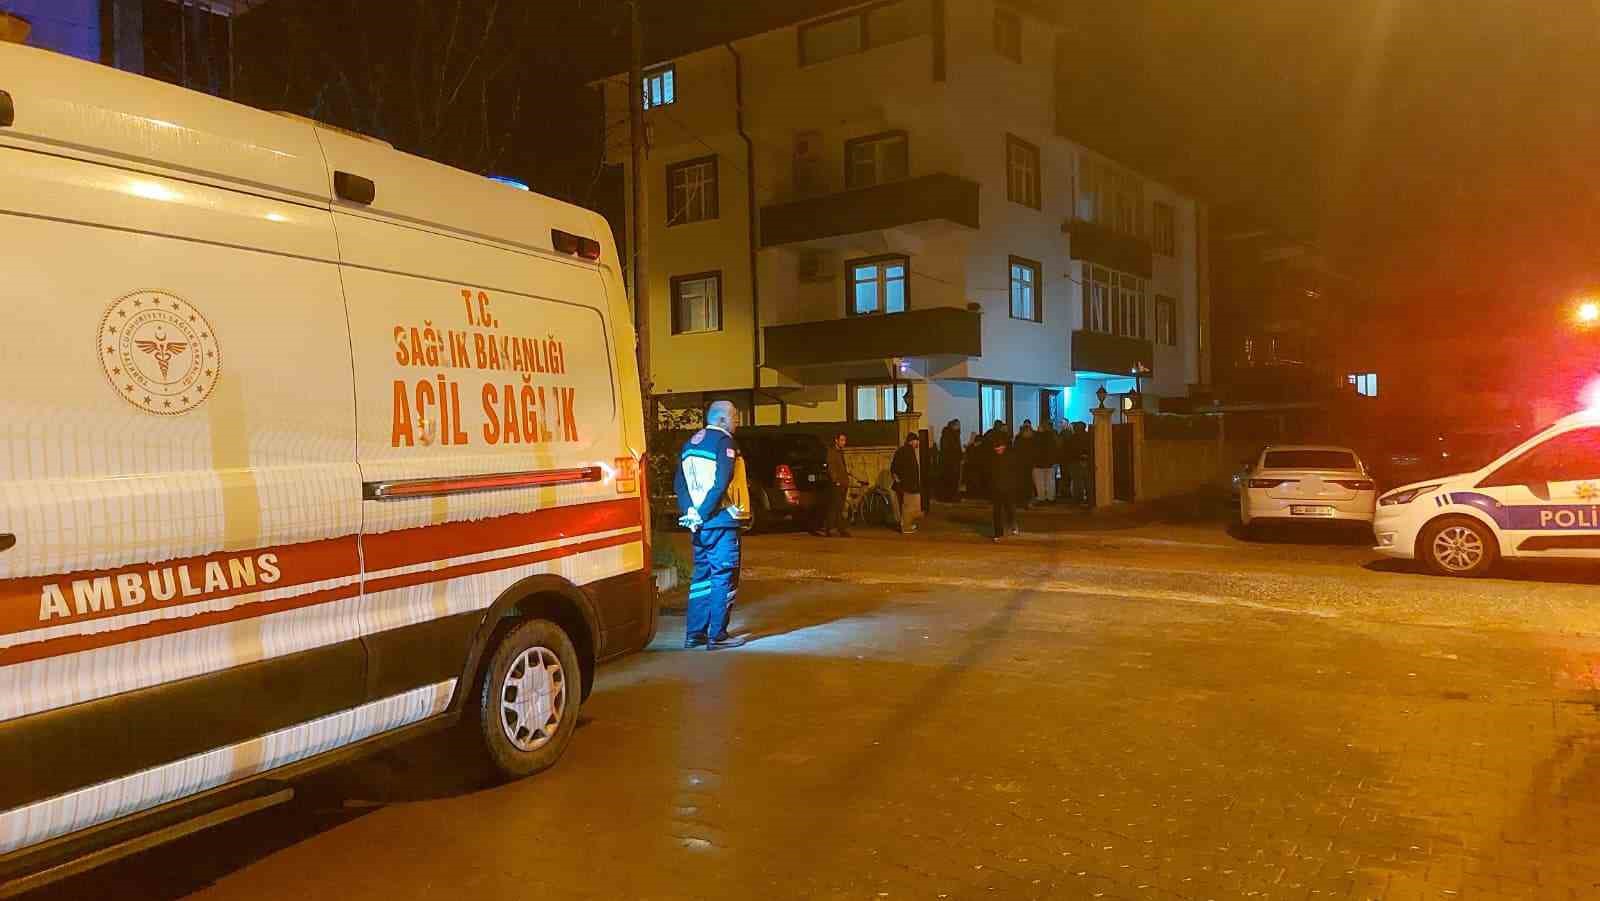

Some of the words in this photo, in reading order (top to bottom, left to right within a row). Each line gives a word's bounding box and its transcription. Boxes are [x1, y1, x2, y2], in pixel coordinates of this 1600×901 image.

[461, 289, 498, 328] T.C.
[473, 332, 566, 375] BAKANLIĞI
[39, 553, 281, 621] AMBULANS
